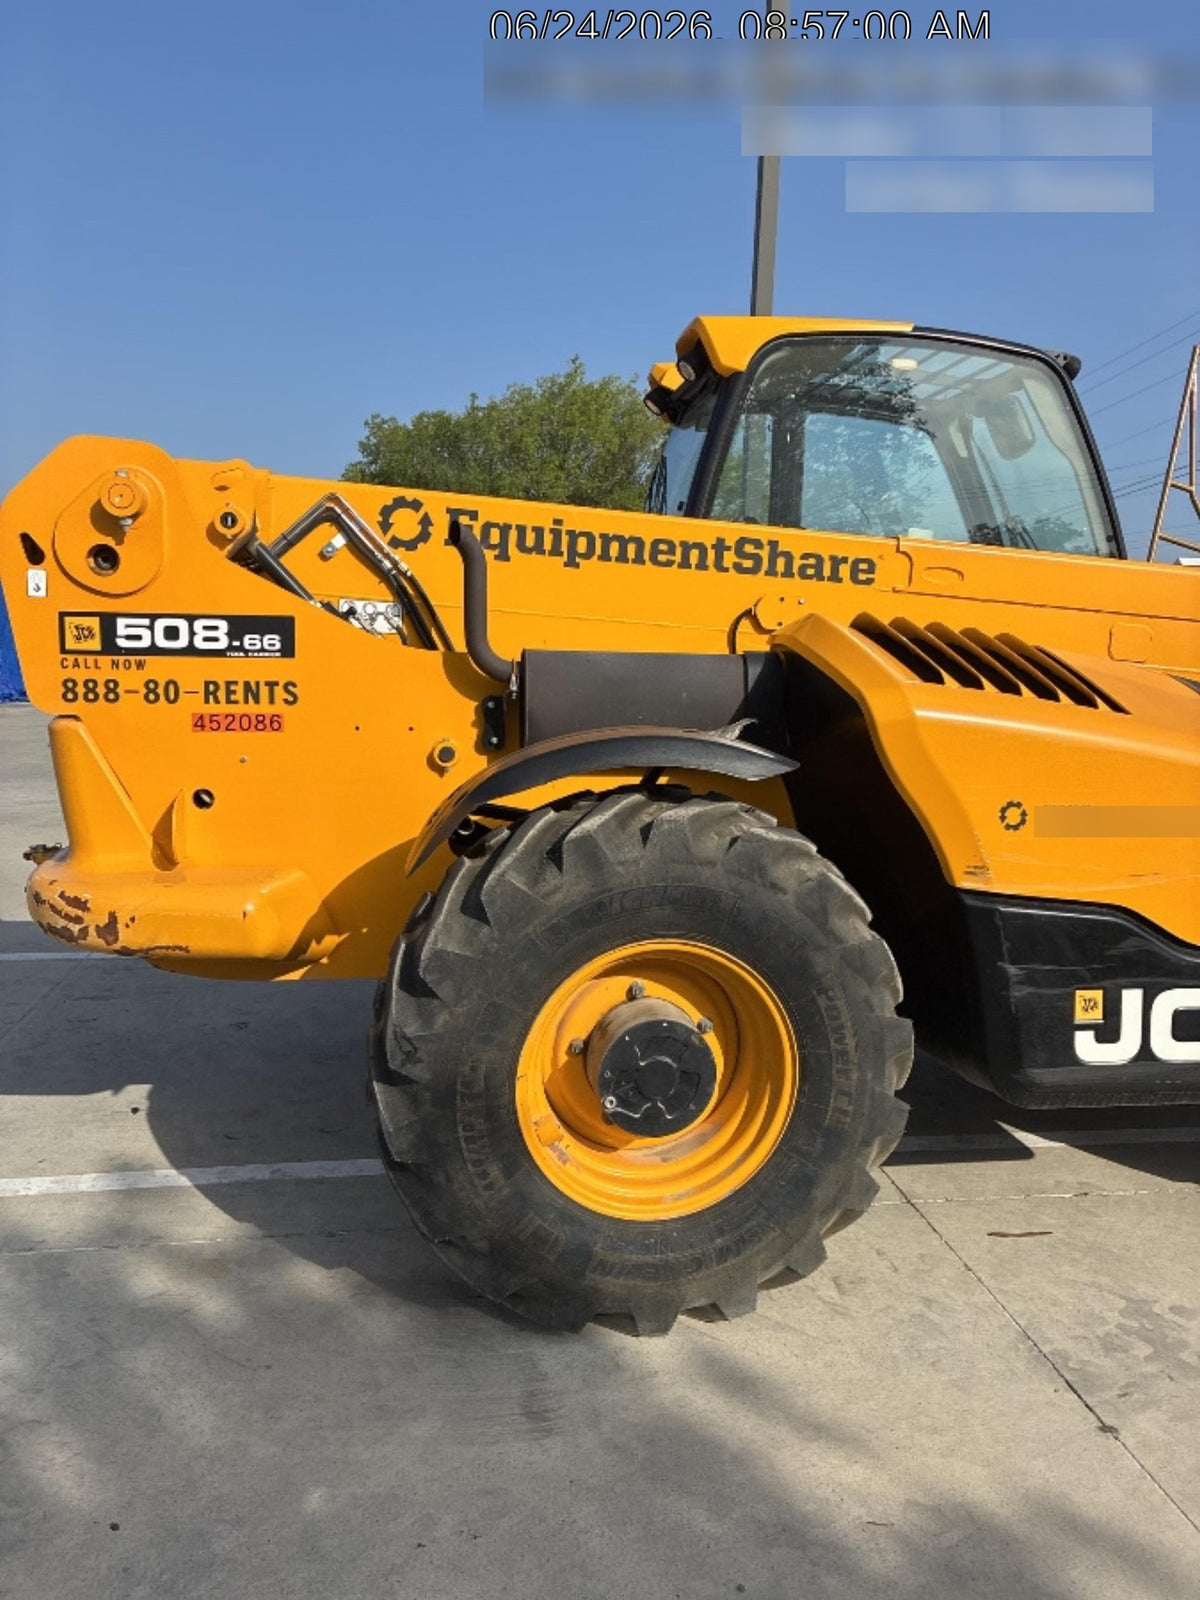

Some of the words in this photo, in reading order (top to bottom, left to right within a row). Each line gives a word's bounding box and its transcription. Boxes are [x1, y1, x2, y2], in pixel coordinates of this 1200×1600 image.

[444, 507, 877, 586] EquipmentShare
[60, 657, 102, 670] CALL
[110, 658, 147, 671] NOW
[61, 677, 299, 706] 888-80-RENTS
[193, 713, 282, 732] 452086
